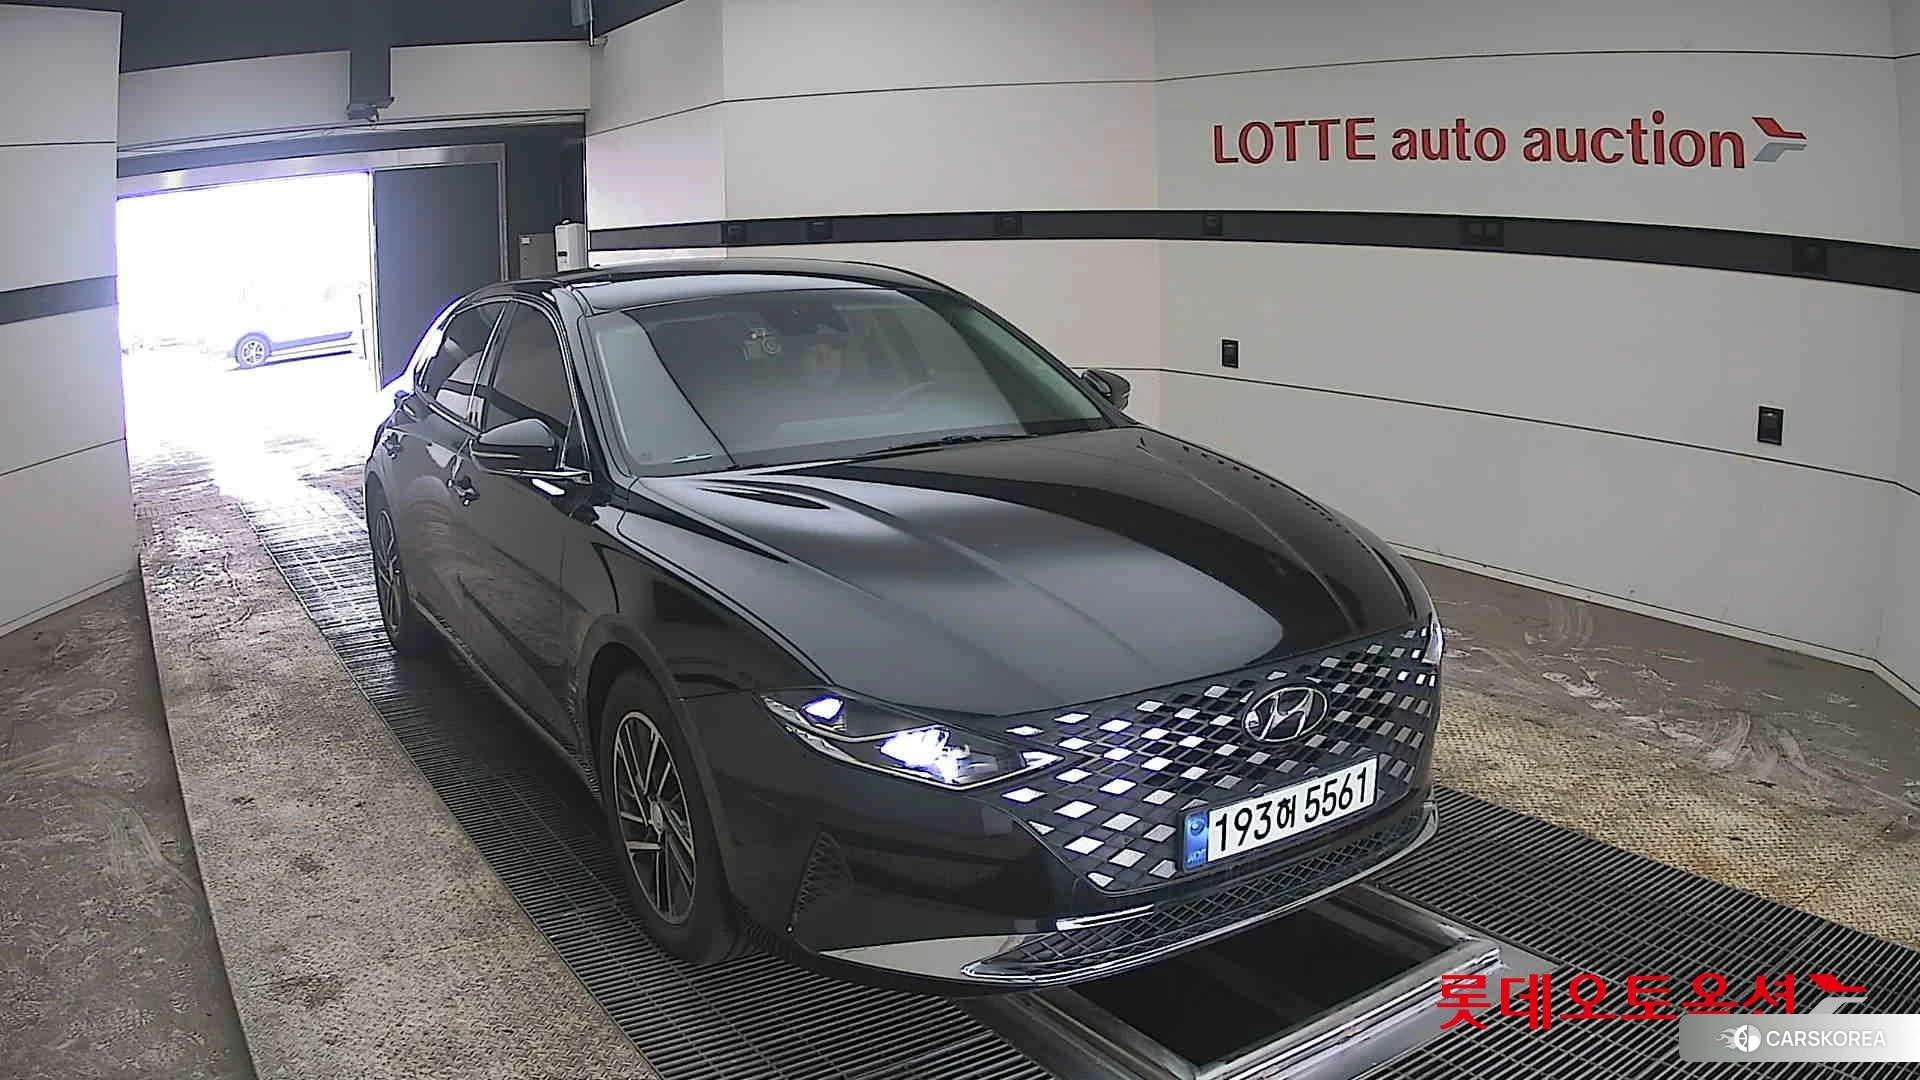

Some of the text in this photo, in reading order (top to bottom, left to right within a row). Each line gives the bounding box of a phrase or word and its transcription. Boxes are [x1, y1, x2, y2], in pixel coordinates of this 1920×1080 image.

[1213, 110, 1746, 169] LOTTE auto auction
[1214, 766, 1368, 852] 193허 5561
